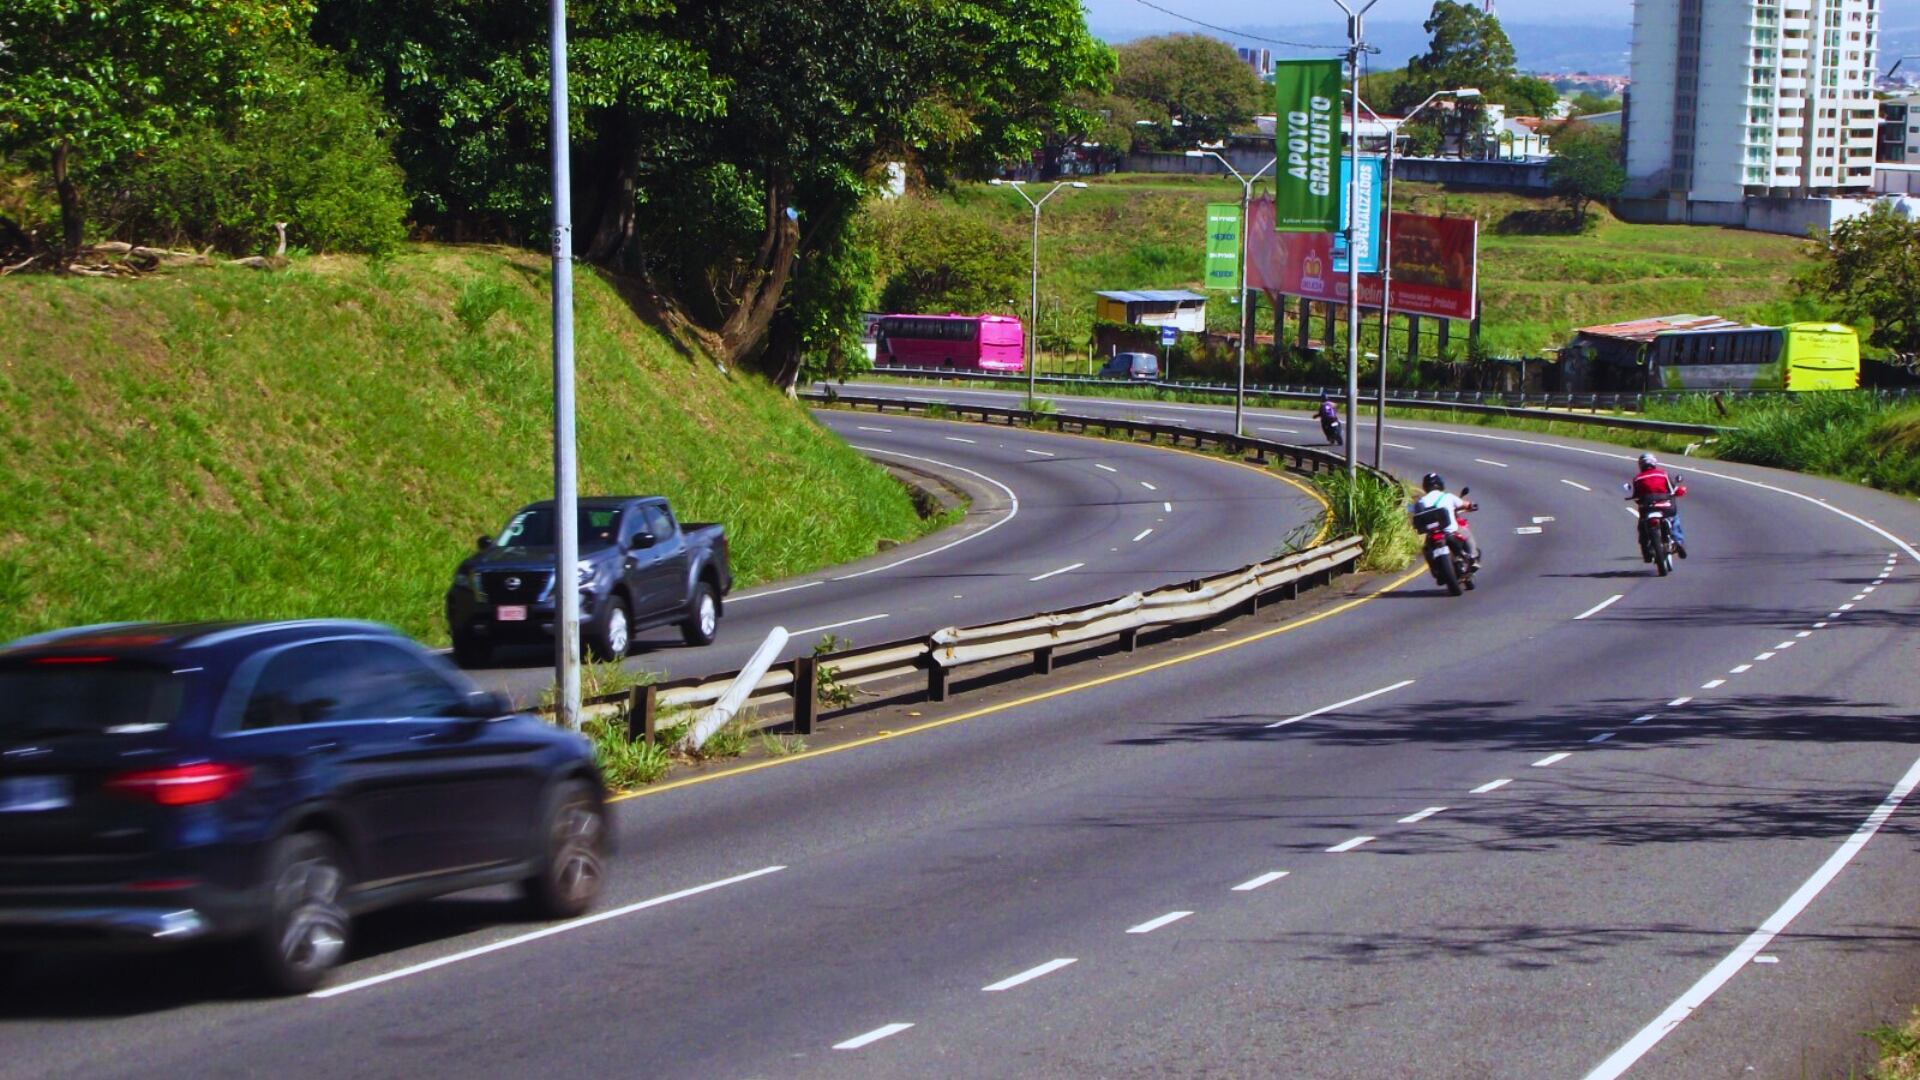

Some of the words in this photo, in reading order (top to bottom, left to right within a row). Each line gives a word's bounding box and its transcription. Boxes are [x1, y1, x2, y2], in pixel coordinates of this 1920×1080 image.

[1288, 111, 1308, 180] APOYO
[1309, 96, 1331, 196] GRATUITO
[1357, 165, 1372, 258] ESPECIALIZADOS
